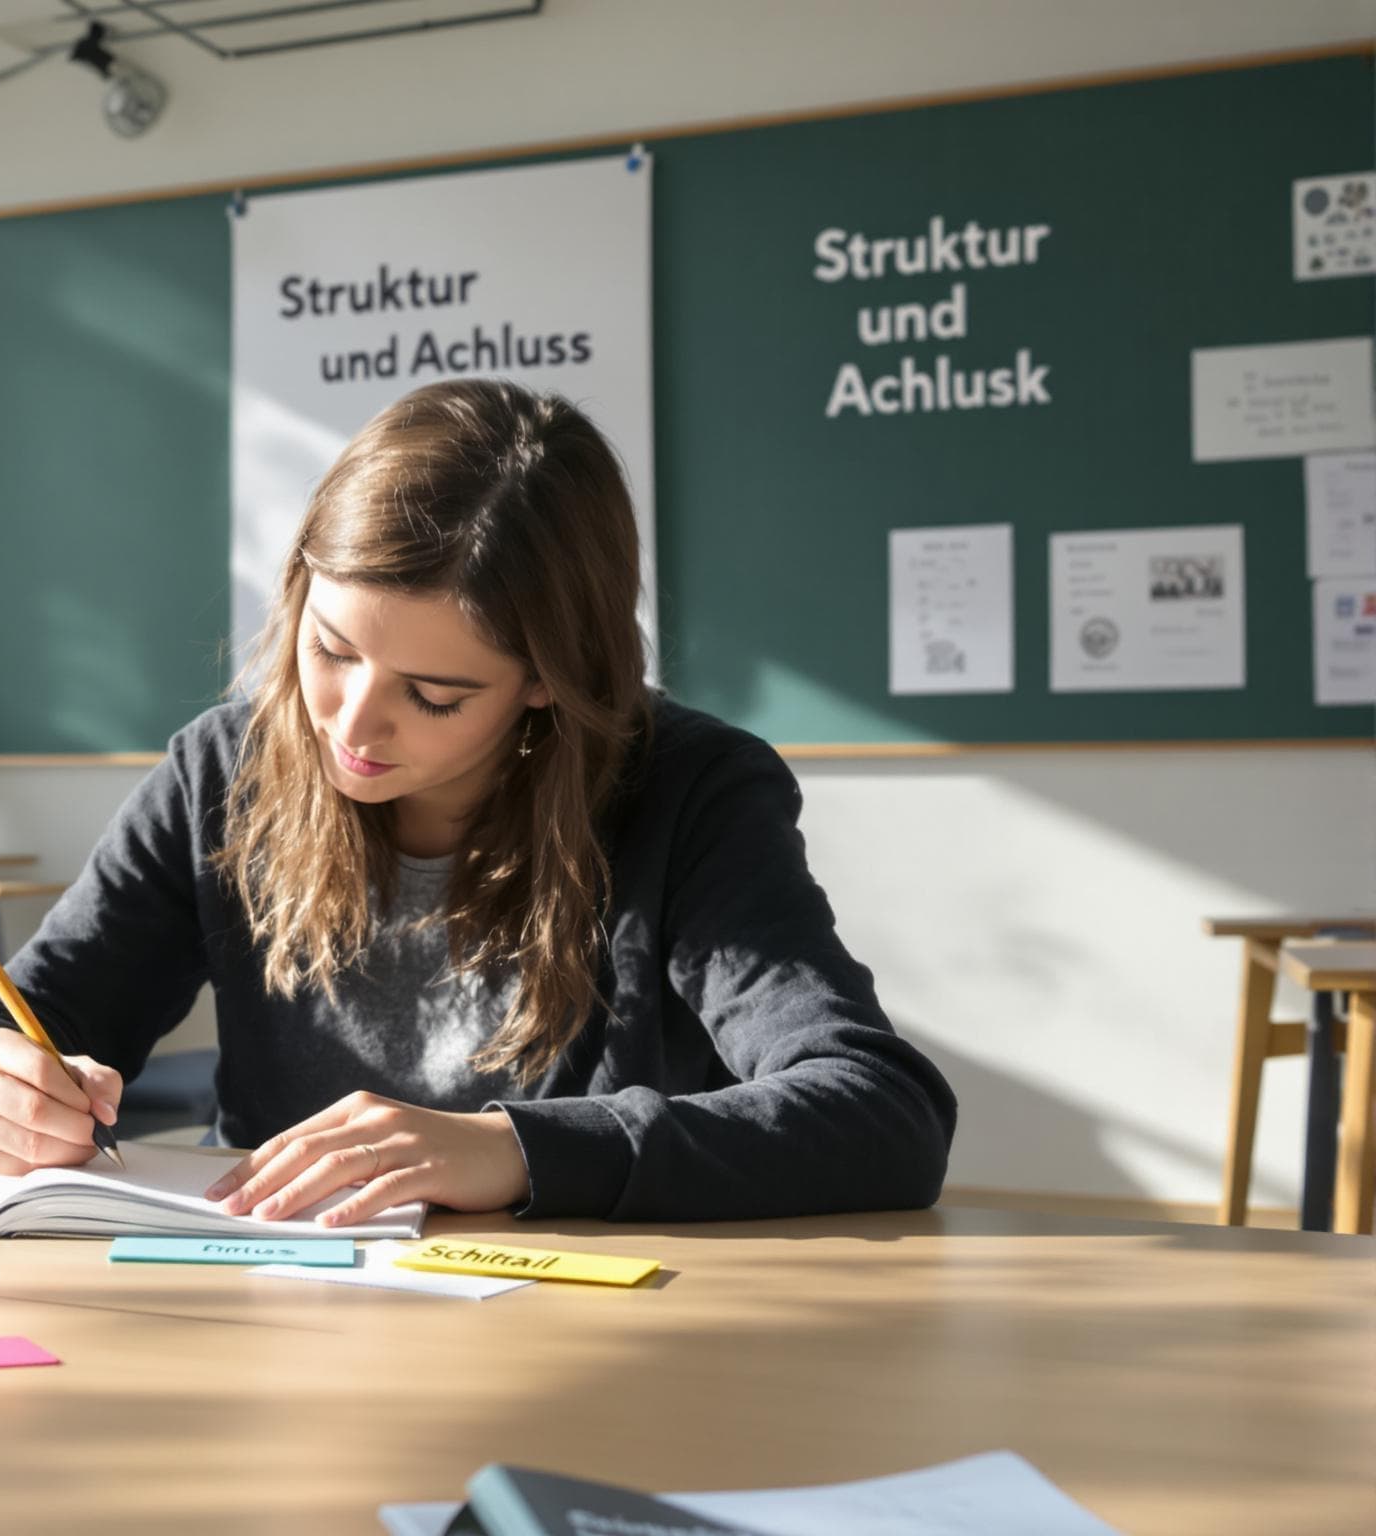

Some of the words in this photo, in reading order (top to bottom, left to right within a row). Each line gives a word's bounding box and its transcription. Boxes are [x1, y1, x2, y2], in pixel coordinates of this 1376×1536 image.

[814, 217, 1050, 282] Struktur
[280, 265, 478, 318] Struktur
[858, 284, 967, 345] und
[321, 335, 399, 382] und
[410, 323, 592, 378] Achluss
[826, 350, 1051, 417] Achlusk
